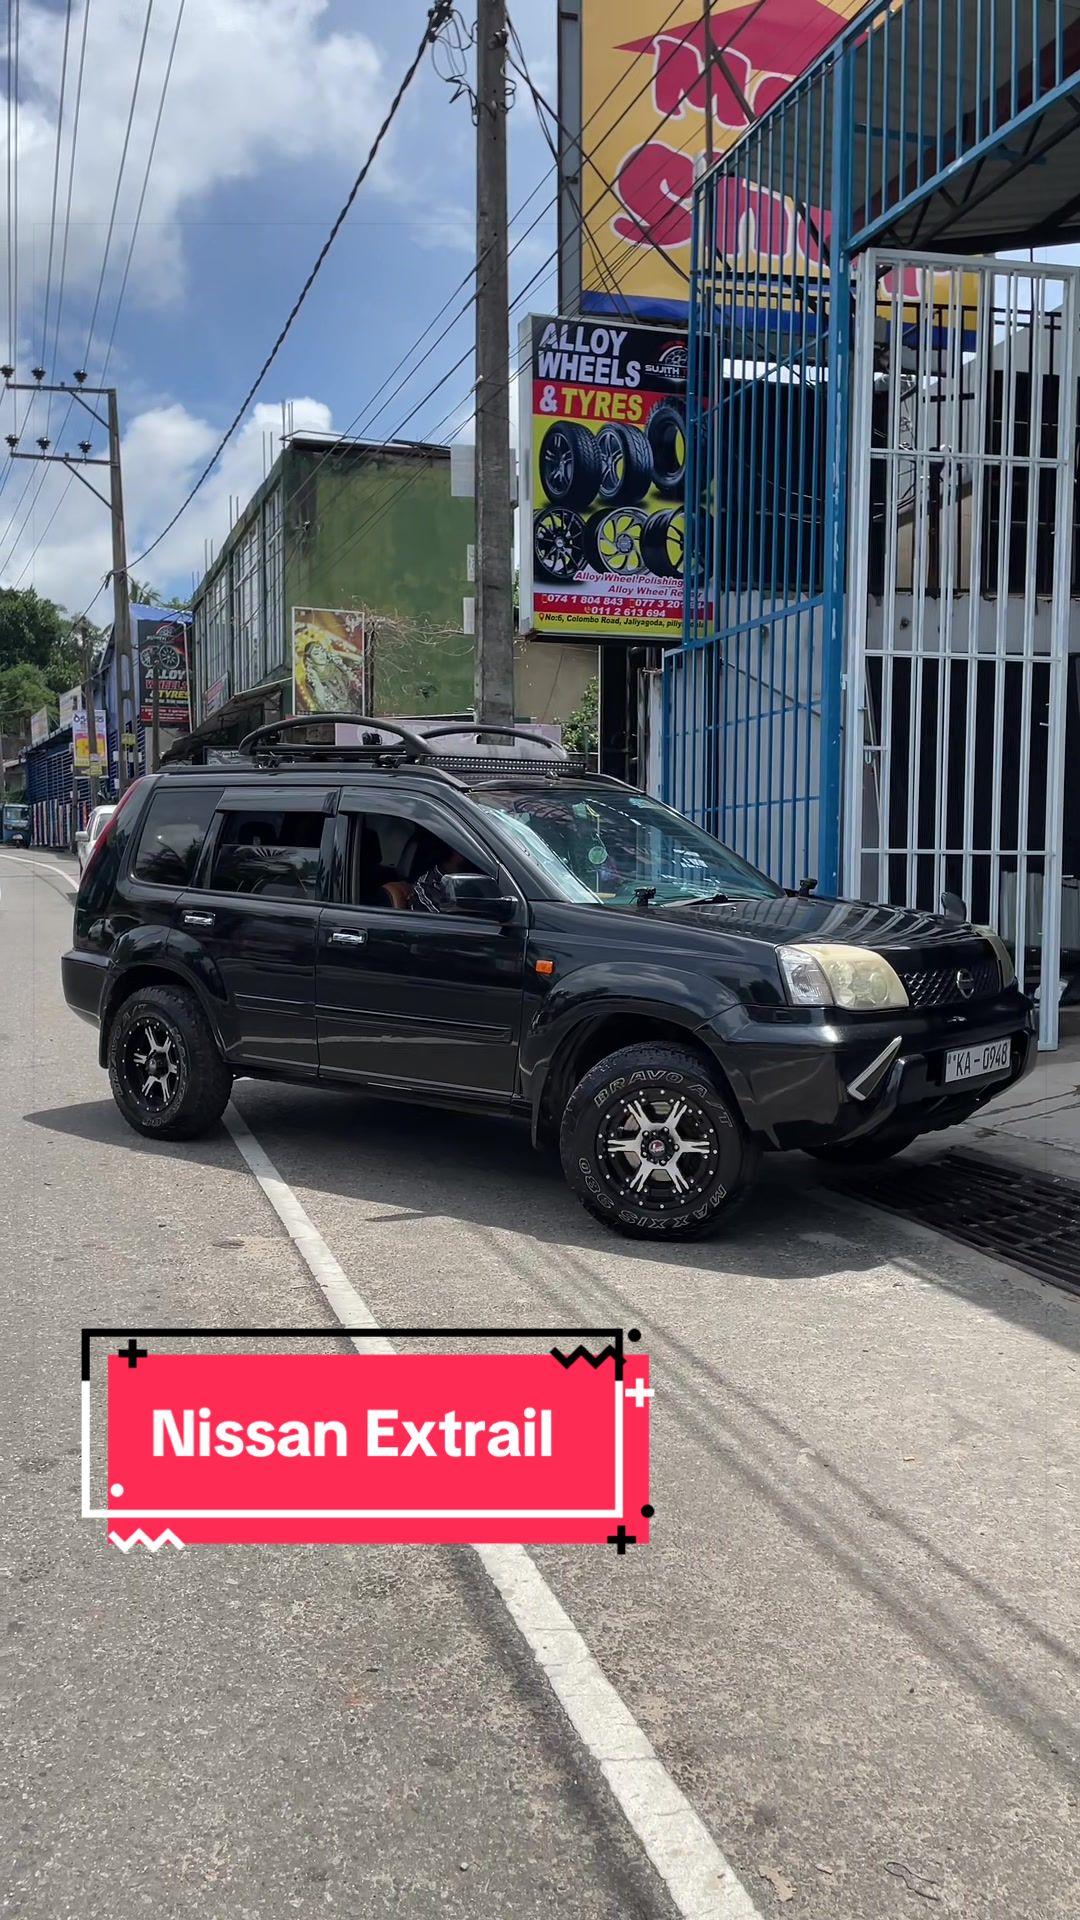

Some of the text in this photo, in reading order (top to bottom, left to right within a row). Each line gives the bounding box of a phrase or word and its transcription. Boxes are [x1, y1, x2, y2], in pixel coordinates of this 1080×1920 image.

[539, 322, 628, 356] ALLOY
[537, 350, 641, 388] WHEELS
[644, 364, 680, 375] SUJITH
[539, 385, 644, 421] & TYRES
[574, 571, 684, 588] Alloy Wheel Polishing
[608, 585, 634, 596] Alloy
[636, 586, 668, 597] Wheel
[547, 594, 569, 603] 074
[580, 597, 601, 605] 804
[603, 598, 624, 606] 843
[635, 599, 654, 608] 077
[545, 613, 564, 622] No:6,
[566, 615, 600, 624] Colombo
[601, 617, 622, 625] Road,
[591, 607, 611, 615] 011
[625, 609, 644, 617] 613
[646, 609, 666, 618] 694
[145, 669, 186, 680] ALOY
[593, 1070, 735, 1128] BRAVO A/T
[619, 1184, 727, 1229] MAXXIS
